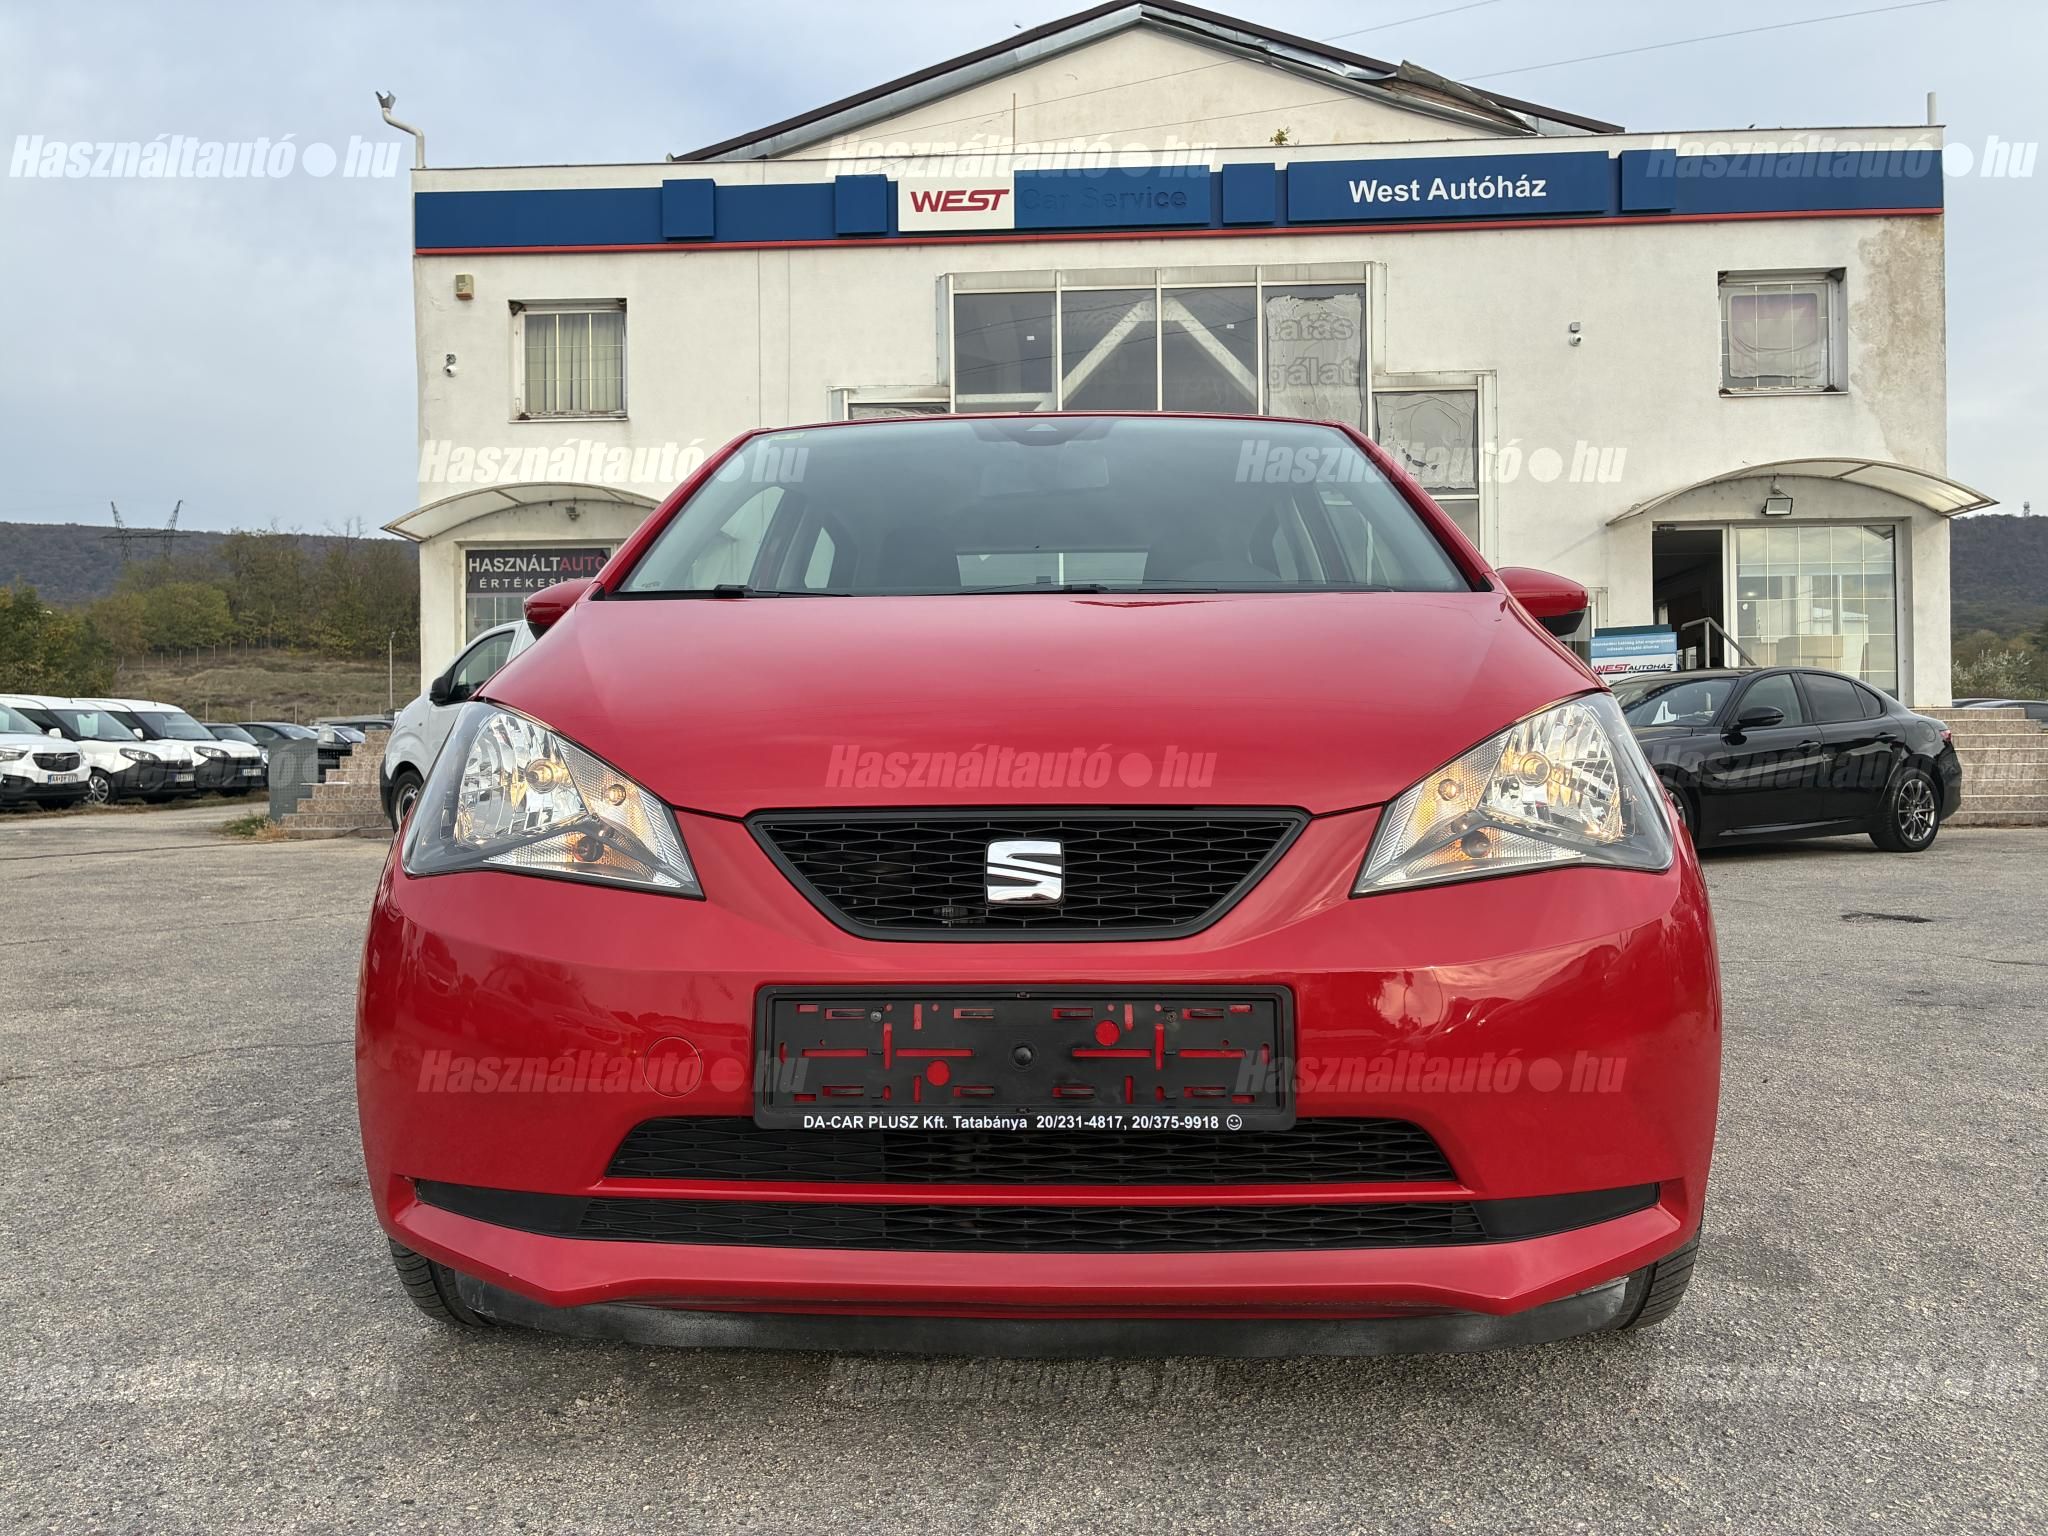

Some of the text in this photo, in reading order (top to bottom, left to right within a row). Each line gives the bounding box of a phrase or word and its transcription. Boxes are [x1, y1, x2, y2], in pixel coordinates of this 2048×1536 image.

[910, 188, 1010, 212] WEST
[1080, 186, 1188, 210] Service
[1348, 174, 1547, 203] West Autóház
[803, 1115, 1219, 1131] DA-CAR PLUSZ Kft. Tatabánya 20/231-4817, 20/375-9918
